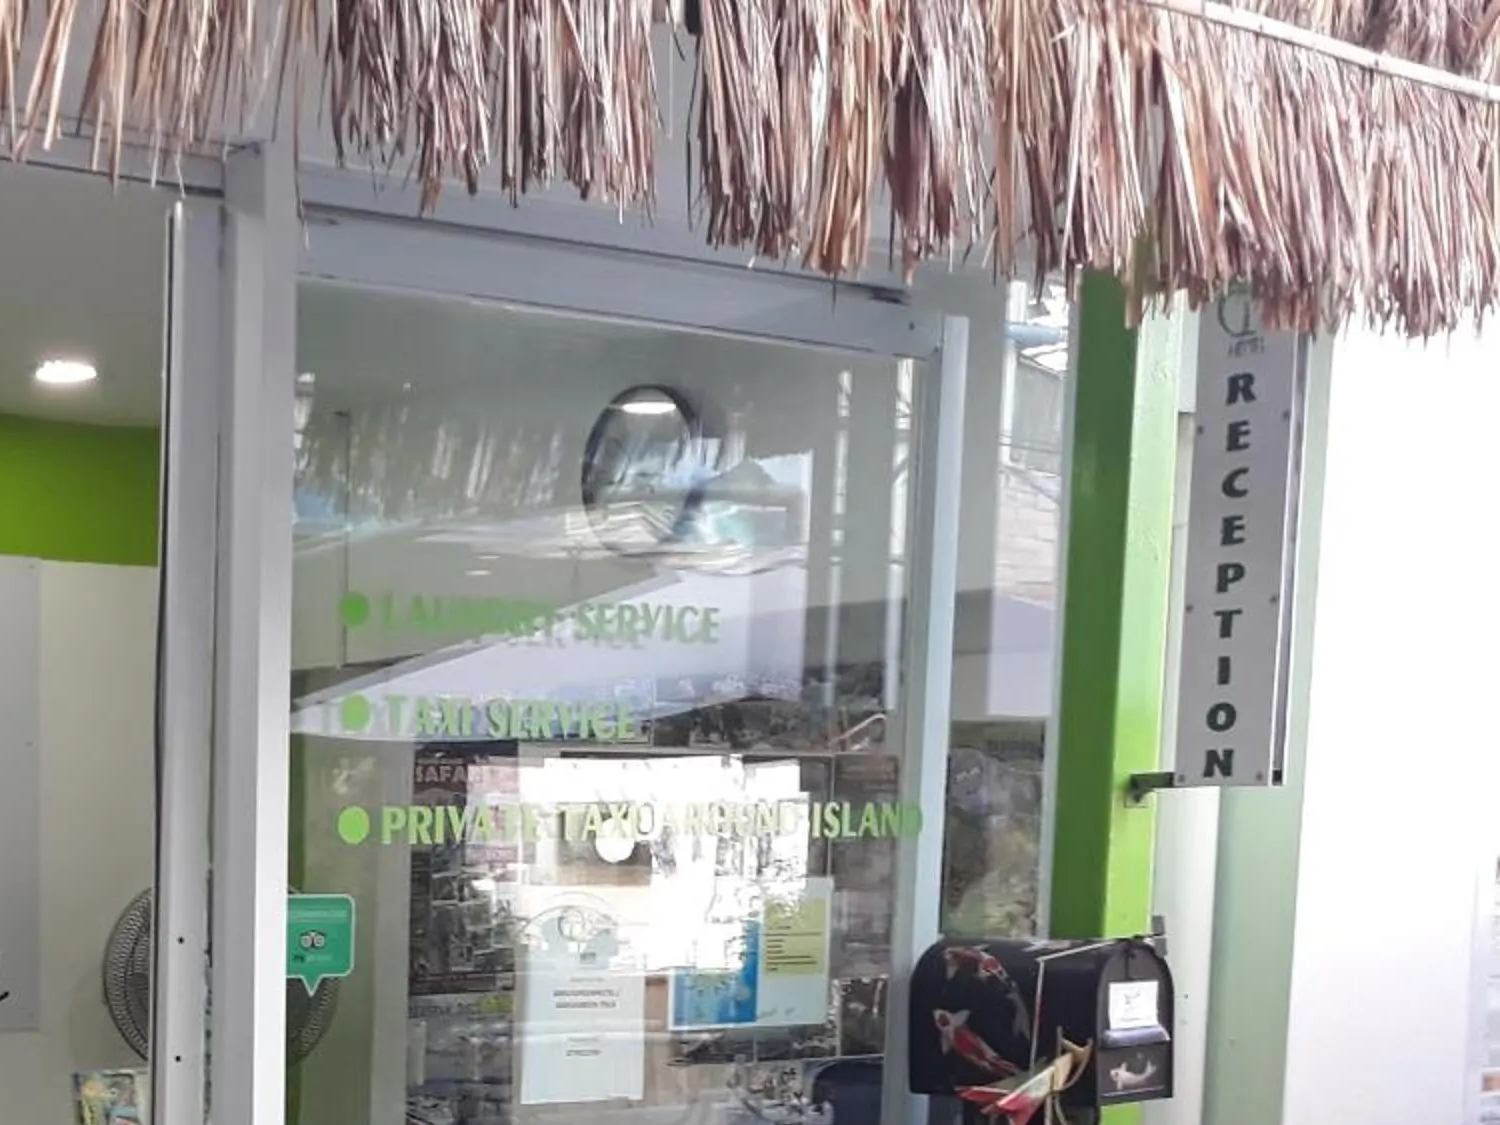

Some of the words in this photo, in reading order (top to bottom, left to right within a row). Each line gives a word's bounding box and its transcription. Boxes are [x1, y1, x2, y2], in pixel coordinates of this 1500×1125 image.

[1201, 372, 1257, 778] RECEPTION
[574, 600, 720, 644] SERVICE
[384, 695, 475, 738] TAXI
[486, 698, 637, 739] SERVICE
[381, 804, 541, 845] PRIVATE
[811, 800, 923, 838] ISLAND
